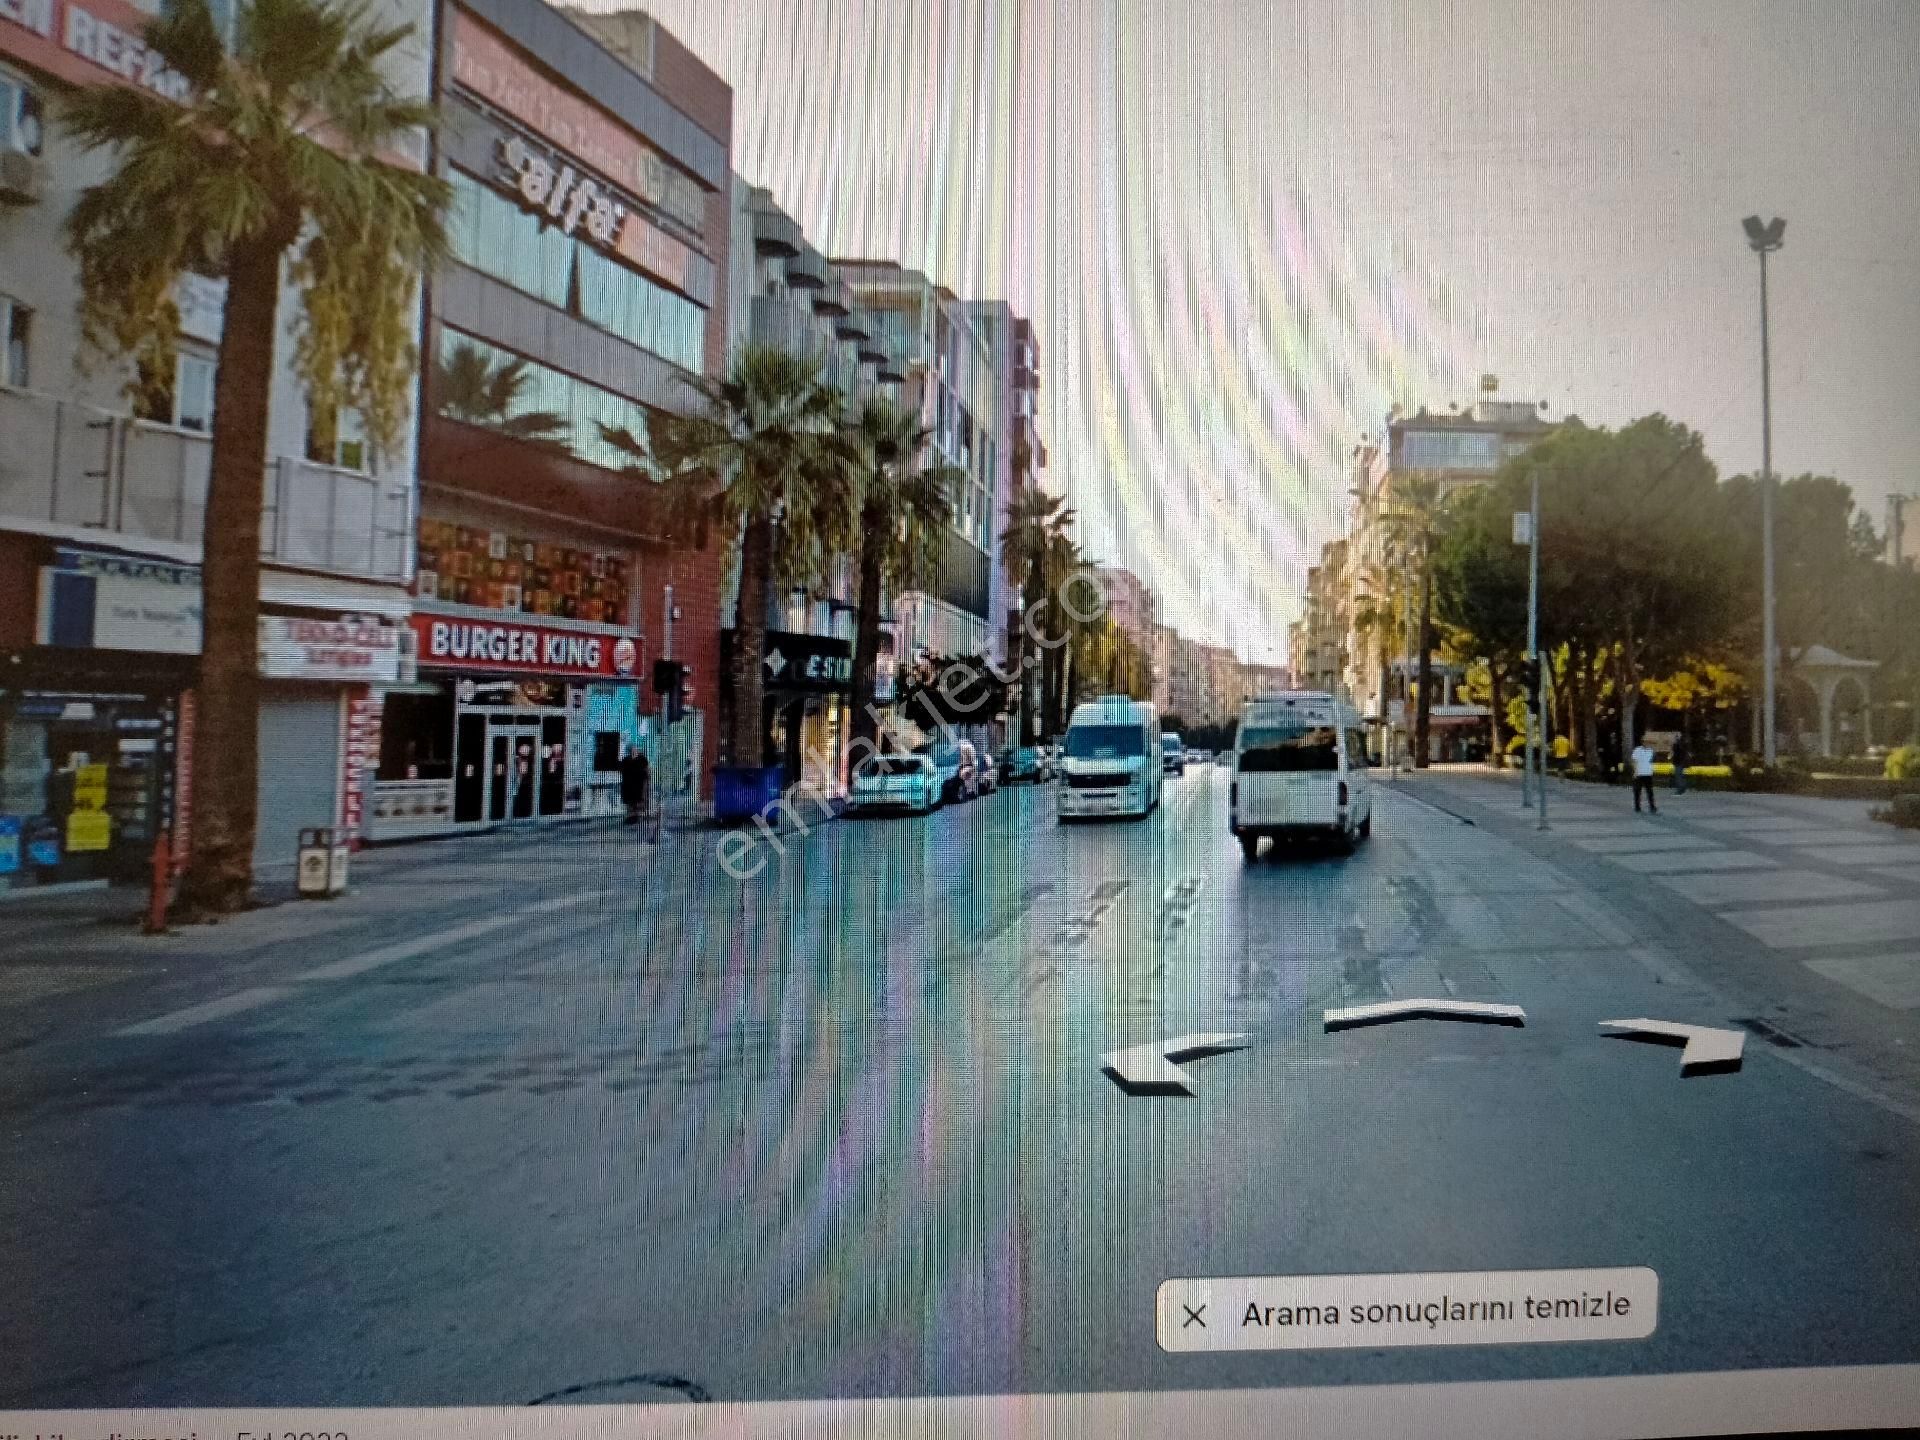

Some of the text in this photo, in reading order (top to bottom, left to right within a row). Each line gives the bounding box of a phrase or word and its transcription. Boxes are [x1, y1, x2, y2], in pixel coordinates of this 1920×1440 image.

[431, 621, 539, 664] BURGER
[543, 633, 602, 668] KING
[1242, 1290, 1631, 1329] Arama sonuçlarını temizle
